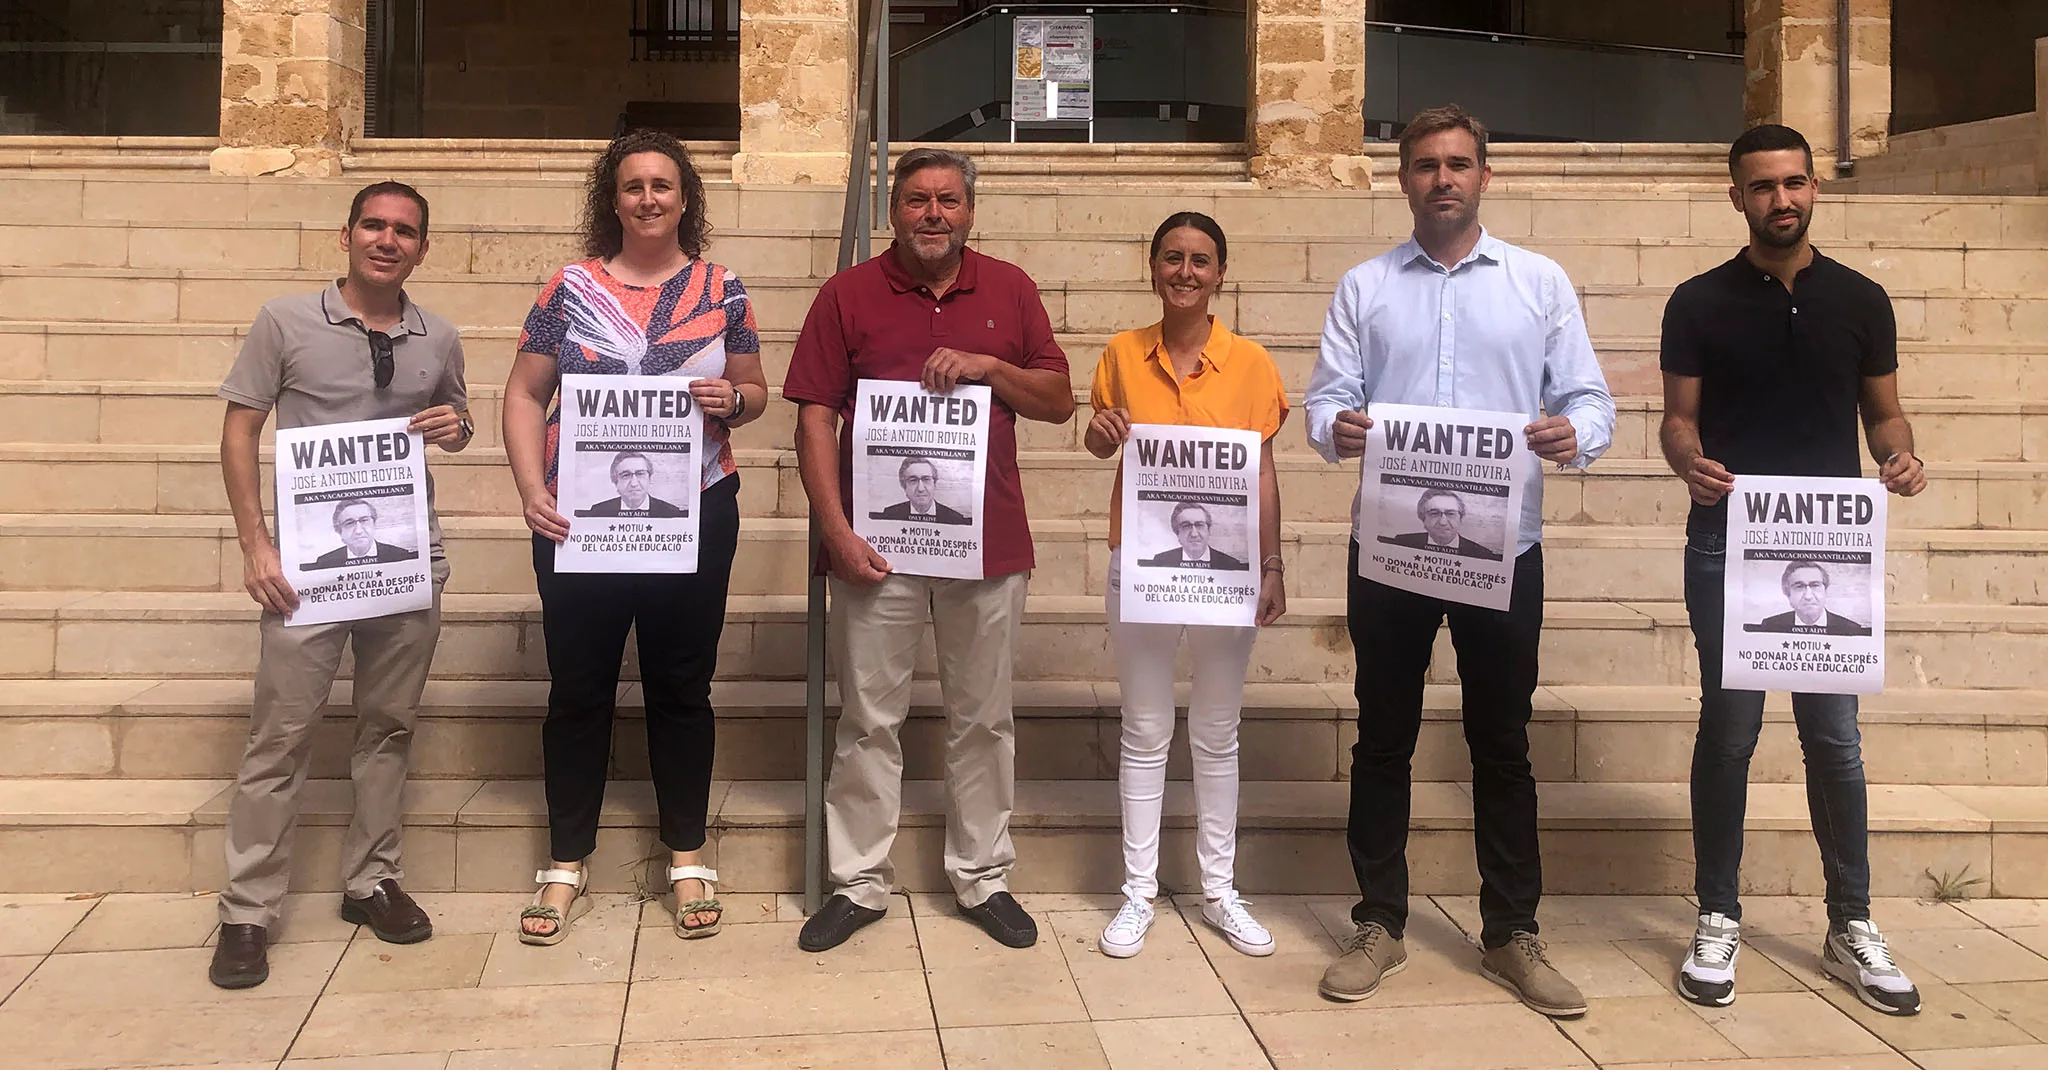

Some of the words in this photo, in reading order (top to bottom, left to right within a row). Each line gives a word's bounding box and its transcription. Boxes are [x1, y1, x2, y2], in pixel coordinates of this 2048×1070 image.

[576, 389, 692, 418] WANTED
[870, 395, 977, 426] WANTED
[574, 422, 598, 437] JOSÉ
[602, 425, 648, 437] ANTONIO
[652, 425, 691, 438] ROVIRA
[865, 427, 888, 441] JOSÉ
[891, 430, 934, 443] ANTONIO
[937, 431, 976, 445] ROVIRA
[1384, 420, 1513, 459] WANTED
[291, 432, 411, 469] WANTED
[1137, 439, 1247, 470] WANTED
[1379, 456, 1406, 470] JOSÉ
[1411, 461, 1461, 475] ANTONIO
[1466, 465, 1511, 481] ROVIRA
[291, 473, 316, 490] JOSÉ
[321, 471, 367, 487] ANTONIO
[371, 467, 413, 482] ROVIRA
[1136, 472, 1158, 486] JOSÉ
[1162, 475, 1205, 488] ANTONIO
[1209, 476, 1248, 490] ROVIRA
[1744, 492, 1873, 525] WANTED
[618, 524, 643, 532] MOTIU
[910, 528, 932, 536] MOTIU
[655, 532, 693, 542] DESPRÉS
[880, 536, 906, 545] DONAR
[909, 537, 917, 545] LA
[920, 538, 941, 547] CARA
[943, 540, 977, 550] DESPRÉS
[1742, 528, 1768, 544] JOSÉ
[1773, 531, 1823, 545] ANTONIO
[1828, 532, 1872, 547] ROVIRA
[894, 545, 914, 554] CAOS
[1424, 556, 1452, 566] MOTIU
[347, 571, 373, 581] MOTIU
[1373, 555, 1385, 563] NO
[1388, 558, 1419, 570] DONAR
[1422, 564, 1432, 572] LA
[1436, 566, 1461, 577] CARA
[1463, 570, 1506, 584] DESPRÉS
[1385, 565, 1400, 574] DEL
[1404, 569, 1429, 580] CAOS
[1432, 574, 1444, 582] EN
[298, 588, 310, 596] NO
[313, 584, 343, 595] DONAR
[359, 578, 383, 589] CARA
[386, 573, 425, 586] DESPRÉS
[1181, 575, 1205, 583] MOTIU
[311, 594, 327, 603] DEL
[330, 591, 354, 601] CAOS
[357, 590, 368, 598] EN
[1134, 584, 1145, 592] NO
[1148, 585, 1176, 593] DONAR
[1191, 586, 1214, 594] CARA
[1217, 585, 1255, 596] DESPRÉS
[1146, 593, 1160, 602] DEL
[1163, 594, 1185, 602] CAOS
[1793, 641, 1821, 650] MOTIU
[1739, 651, 1752, 659] NO
[1755, 651, 1787, 661] DONAR
[1791, 653, 1801, 661] LA
[1805, 653, 1831, 663] CARA
[1834, 652, 1878, 664] DESPRÉS
[1752, 661, 1769, 670] DEL
[1772, 662, 1798, 671] CAOS
[1801, 663, 1814, 671] EN
